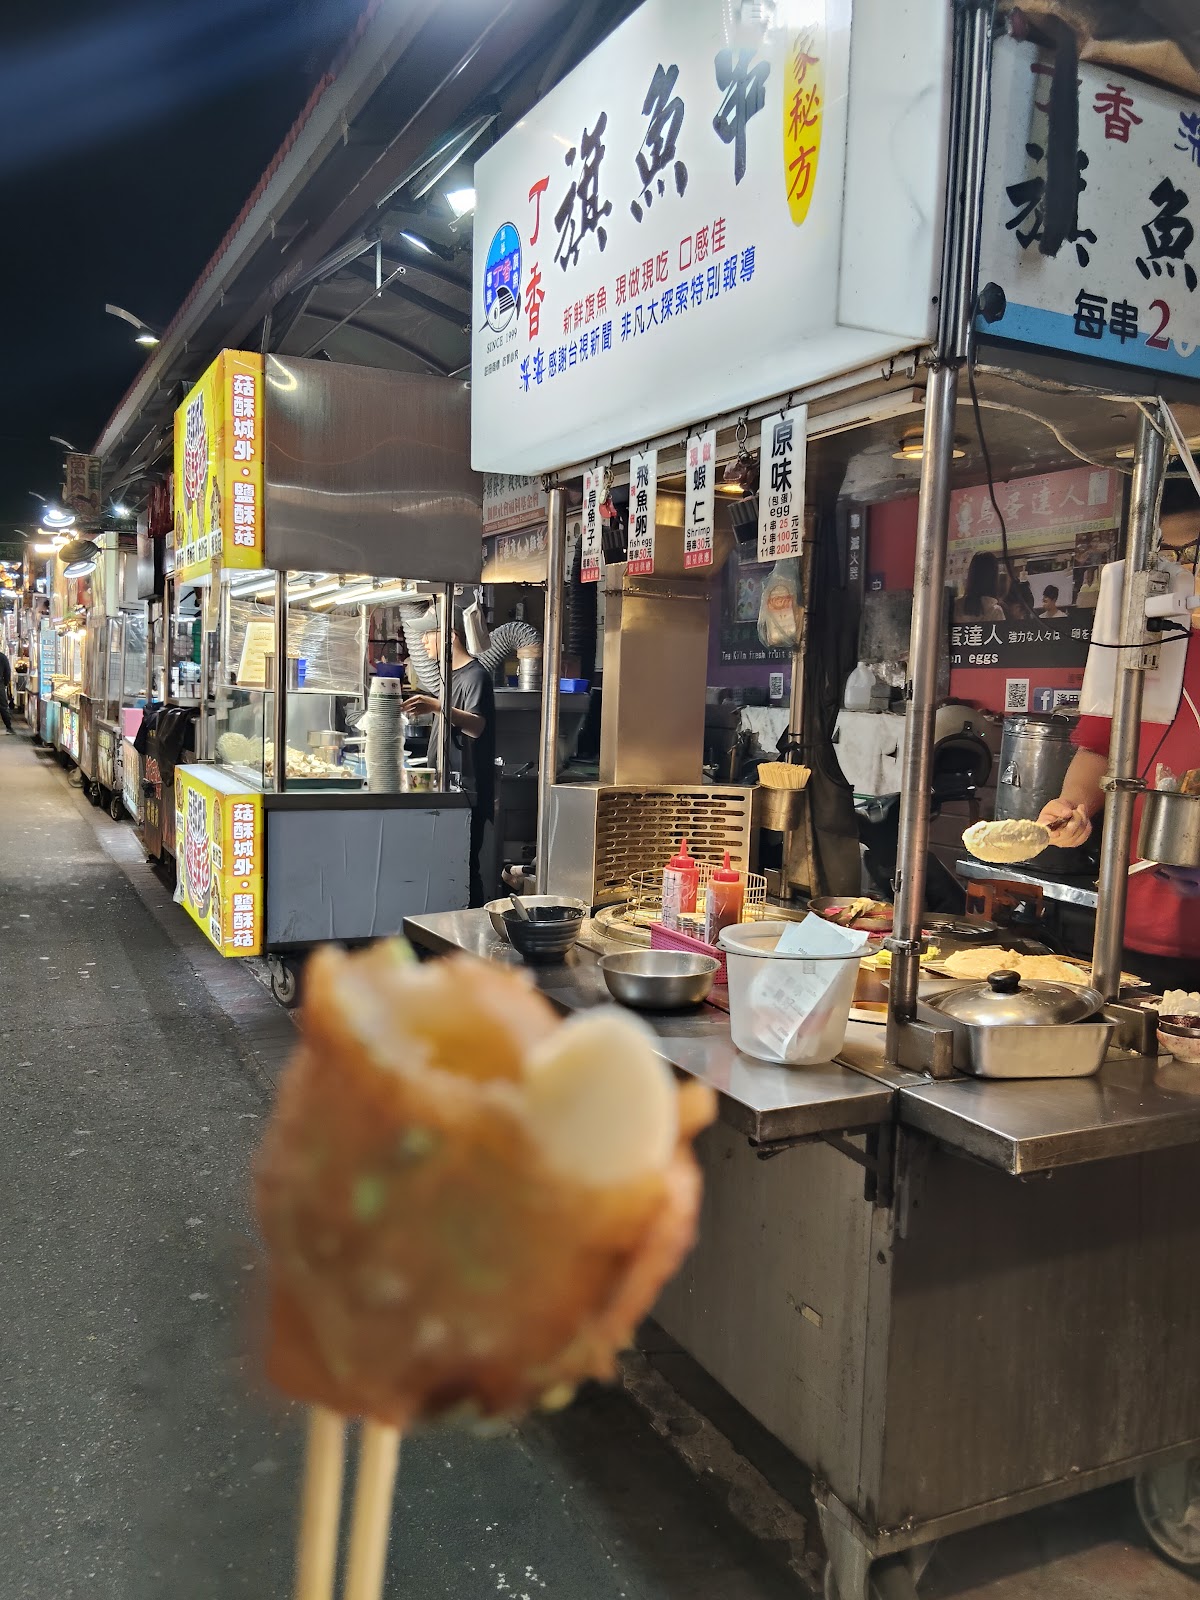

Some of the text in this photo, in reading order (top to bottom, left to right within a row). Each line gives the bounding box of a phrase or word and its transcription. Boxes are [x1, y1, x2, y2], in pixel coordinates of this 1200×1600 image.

[553, 49, 771, 272] 旗魚串
[1005, 143, 1198, 293] 旗魚
[493, 258, 512, 288] 丁香
[524, 175, 549, 342] 丁香
[563, 216, 726, 336] 新鮮旗魚 現做現吃 口感佳
[549, 245, 756, 378] 感謝台視新聞 非凡大探索特別報導
[487, 327, 518, 354] SINCE 1999
[690, 443, 711, 467] 現做
[771, 418, 794, 492] 原味
[635, 464, 648, 538] 飛魚卵
[693, 464, 706, 525] 蝦仁
[770, 505, 790, 518] egg
[587, 490, 596, 546] 烏魚子
[686, 526, 711, 538] Shrimp
[629, 538, 653, 548] fish egg
[733, 650, 747, 660] Kiln
[749, 650, 766, 659] fresh
[1071, 627, 1092, 641] 卵を
[968, 653, 999, 665] eggs
